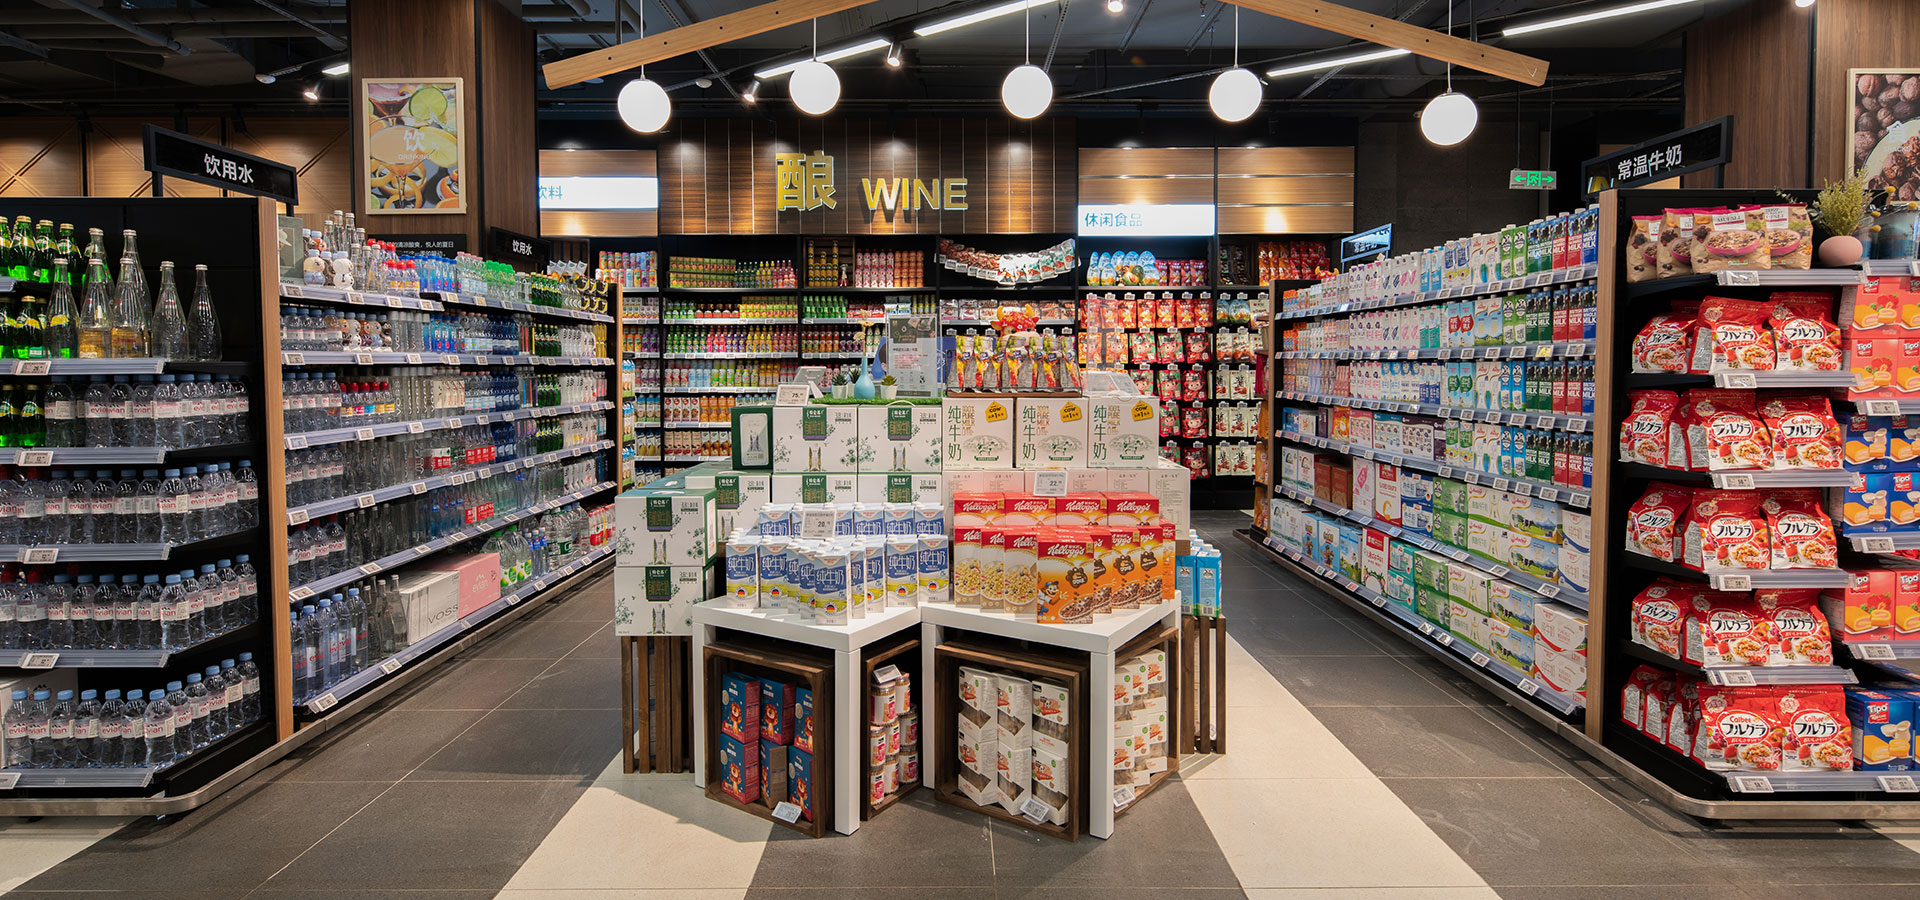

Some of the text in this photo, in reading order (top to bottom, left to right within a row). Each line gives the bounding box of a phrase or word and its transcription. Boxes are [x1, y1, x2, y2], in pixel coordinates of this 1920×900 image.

[204, 153, 254, 183] 饮用水
[1617, 144, 1682, 180] 常温牛奶
[776, 150, 836, 210] 酿
[861, 178, 968, 210] WINE
[1085, 212, 1142, 227] 休闲食品
[512, 239, 532, 256] 饮用水
[1785, 328, 1823, 338] フルグラ
[948, 405, 962, 461] 纯牛奶
[1023, 405, 1036, 461] 纯牛奶
[1093, 404, 1107, 460] 纯牛奶
[1783, 424, 1822, 436] フルグラ
[962, 502, 997, 513] Kellogg's
[1014, 502, 1048, 512] Kellogg's
[1065, 502, 1100, 512] Kellogg's
[1117, 502, 1152, 512] Kellogg's
[760, 522, 788, 536] 纯牛奶
[854, 522, 882, 536] 纯牛奶
[884, 522, 912, 536] 纯牛奶
[916, 521, 943, 536] 纯牛奶
[1716, 523, 1750, 537] フルグラ
[1774, 518, 1811, 529] フルグラ
[920, 550, 946, 566] 纯牛奶
[1048, 544, 1086, 558] Kellogg's
[728, 556, 754, 572] 纯牛奶
[762, 556, 788, 572] 纯牛奶
[889, 555, 916, 570] 纯牛奶
[816, 570, 844, 585] 纯牛奶
[1900, 574, 1919, 584] Tipo
[428, 604, 458, 624] VOSS
[1712, 620, 1750, 631] フルグラ
[1776, 619, 1813, 630] フルグラ
[1867, 704, 1888, 714] Tipo
[1722, 723, 1766, 736] フルグラ
[1795, 722, 1836, 735] フルグラ
